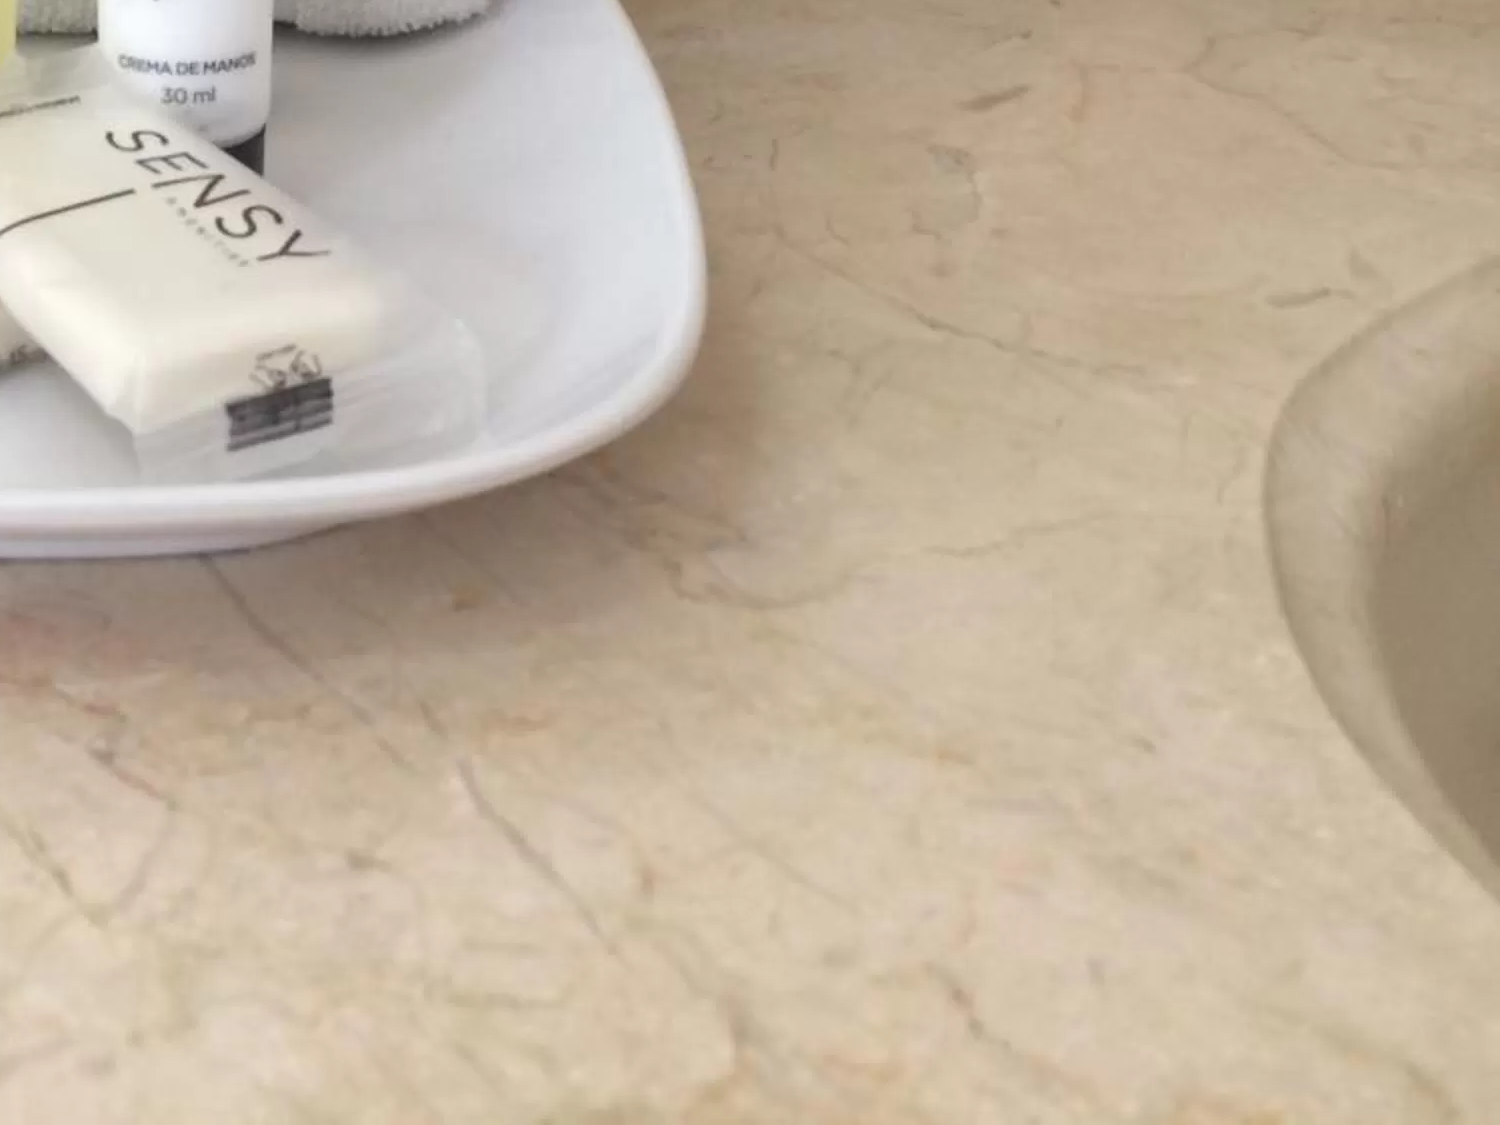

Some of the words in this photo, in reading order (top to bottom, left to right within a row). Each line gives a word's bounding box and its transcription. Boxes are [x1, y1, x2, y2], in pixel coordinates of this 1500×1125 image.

[118, 54, 172, 75] CREMA
[175, 61, 199, 76] DE
[203, 51, 256, 73] MANOS
[161, 87, 187, 104] 30
[193, 86, 216, 104] ml
[105, 130, 332, 261] SENSY
